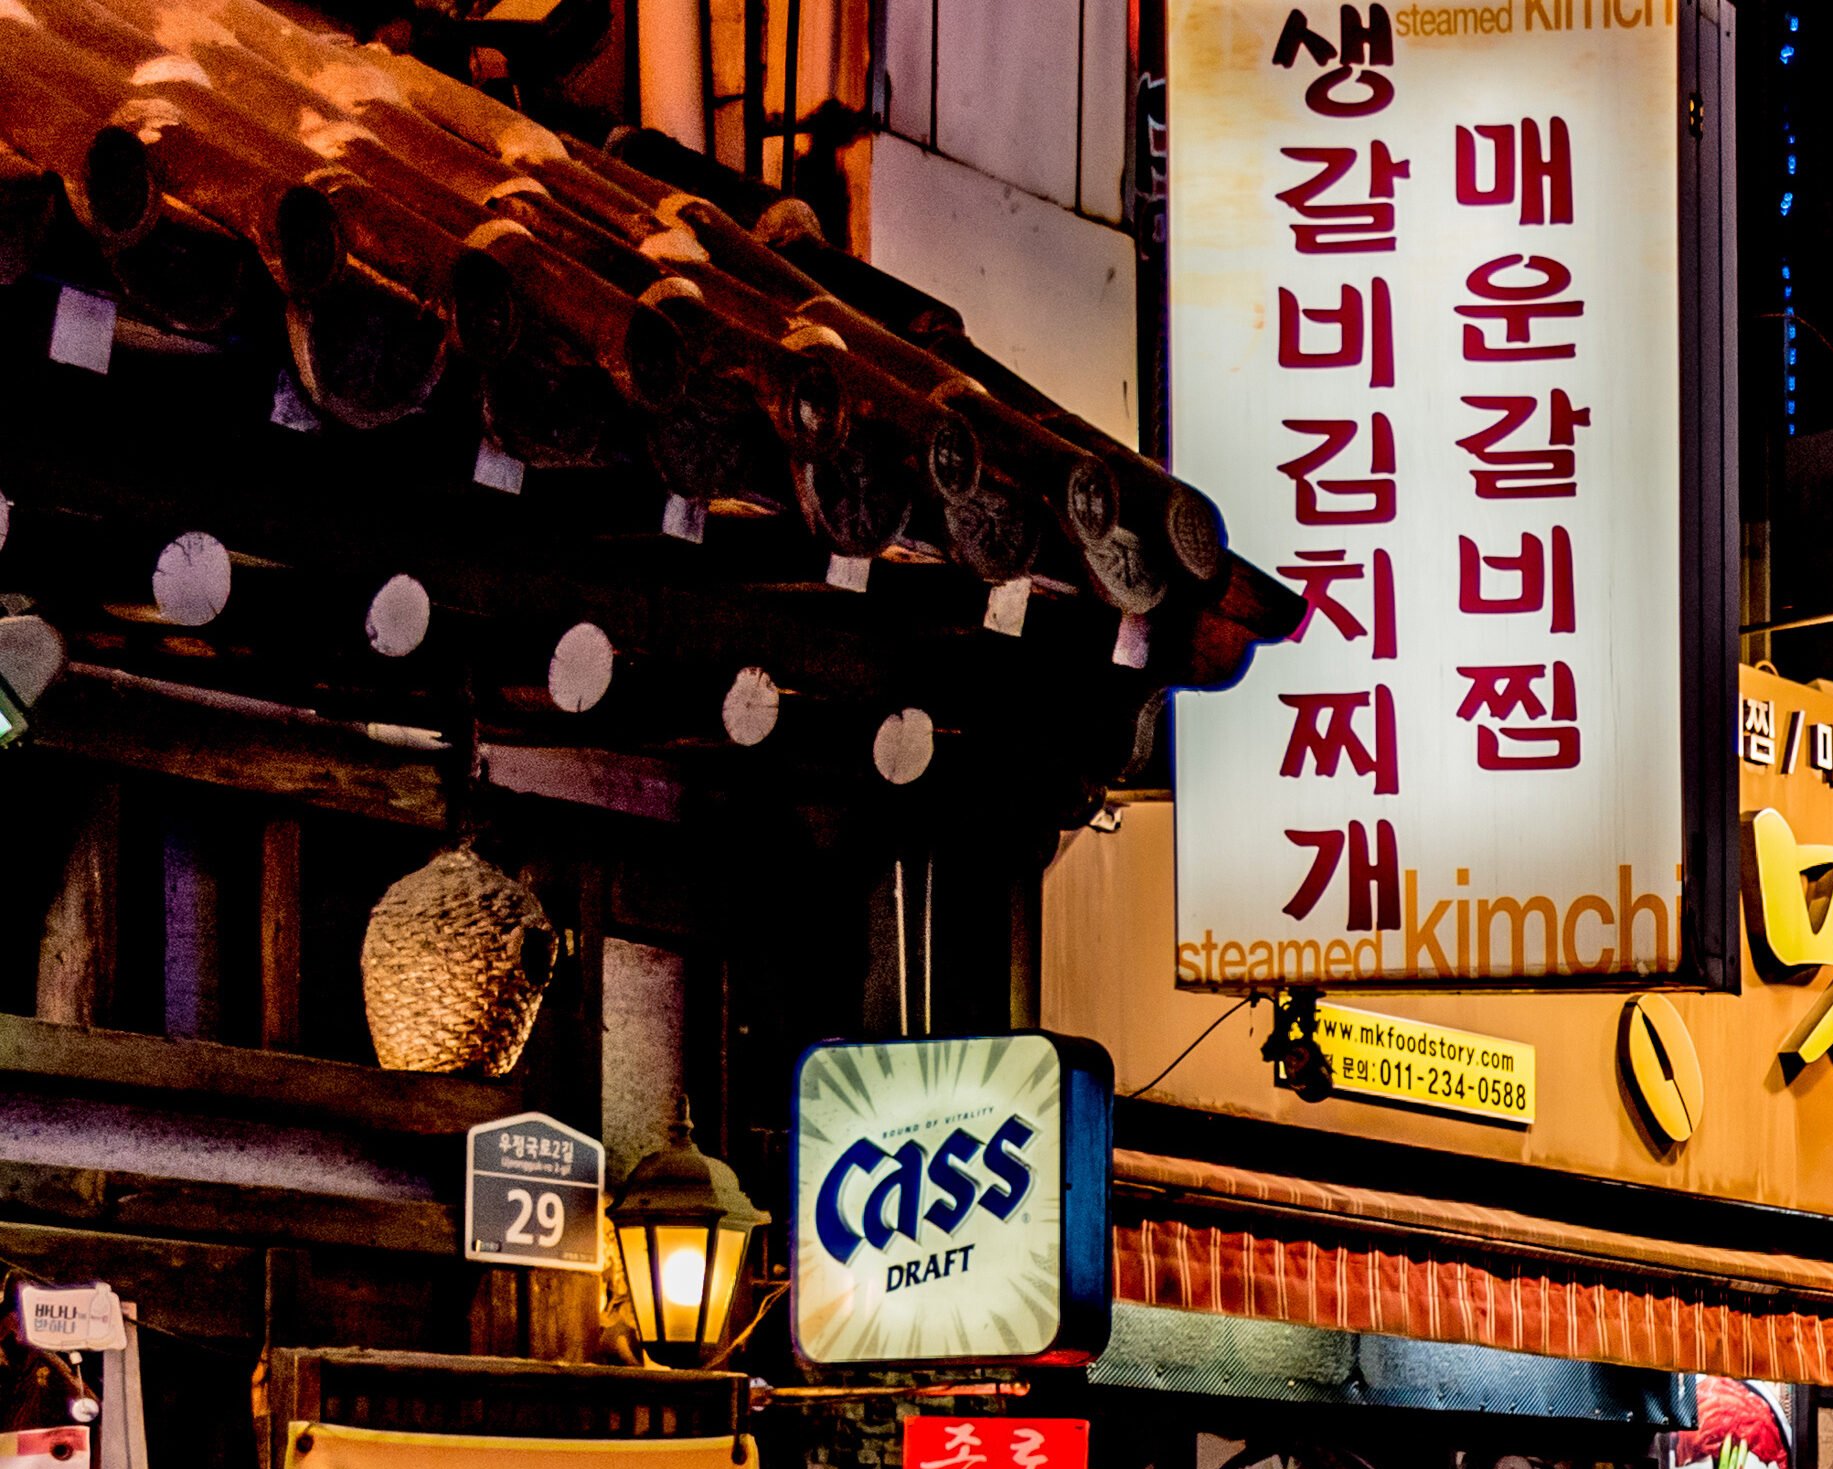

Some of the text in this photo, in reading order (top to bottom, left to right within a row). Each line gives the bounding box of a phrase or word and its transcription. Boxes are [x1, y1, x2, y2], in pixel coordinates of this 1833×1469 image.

[1272, 2, 1411, 932] 생갈비김치찌개
[1454, 114, 1592, 771] 매운갈비찜
[1177, 863, 1683, 983] steamed kimchi
[506, 1189, 564, 1247] 29
[815, 1115, 1040, 1266] Cass
[885, 1243, 975, 1293] DRAFT
